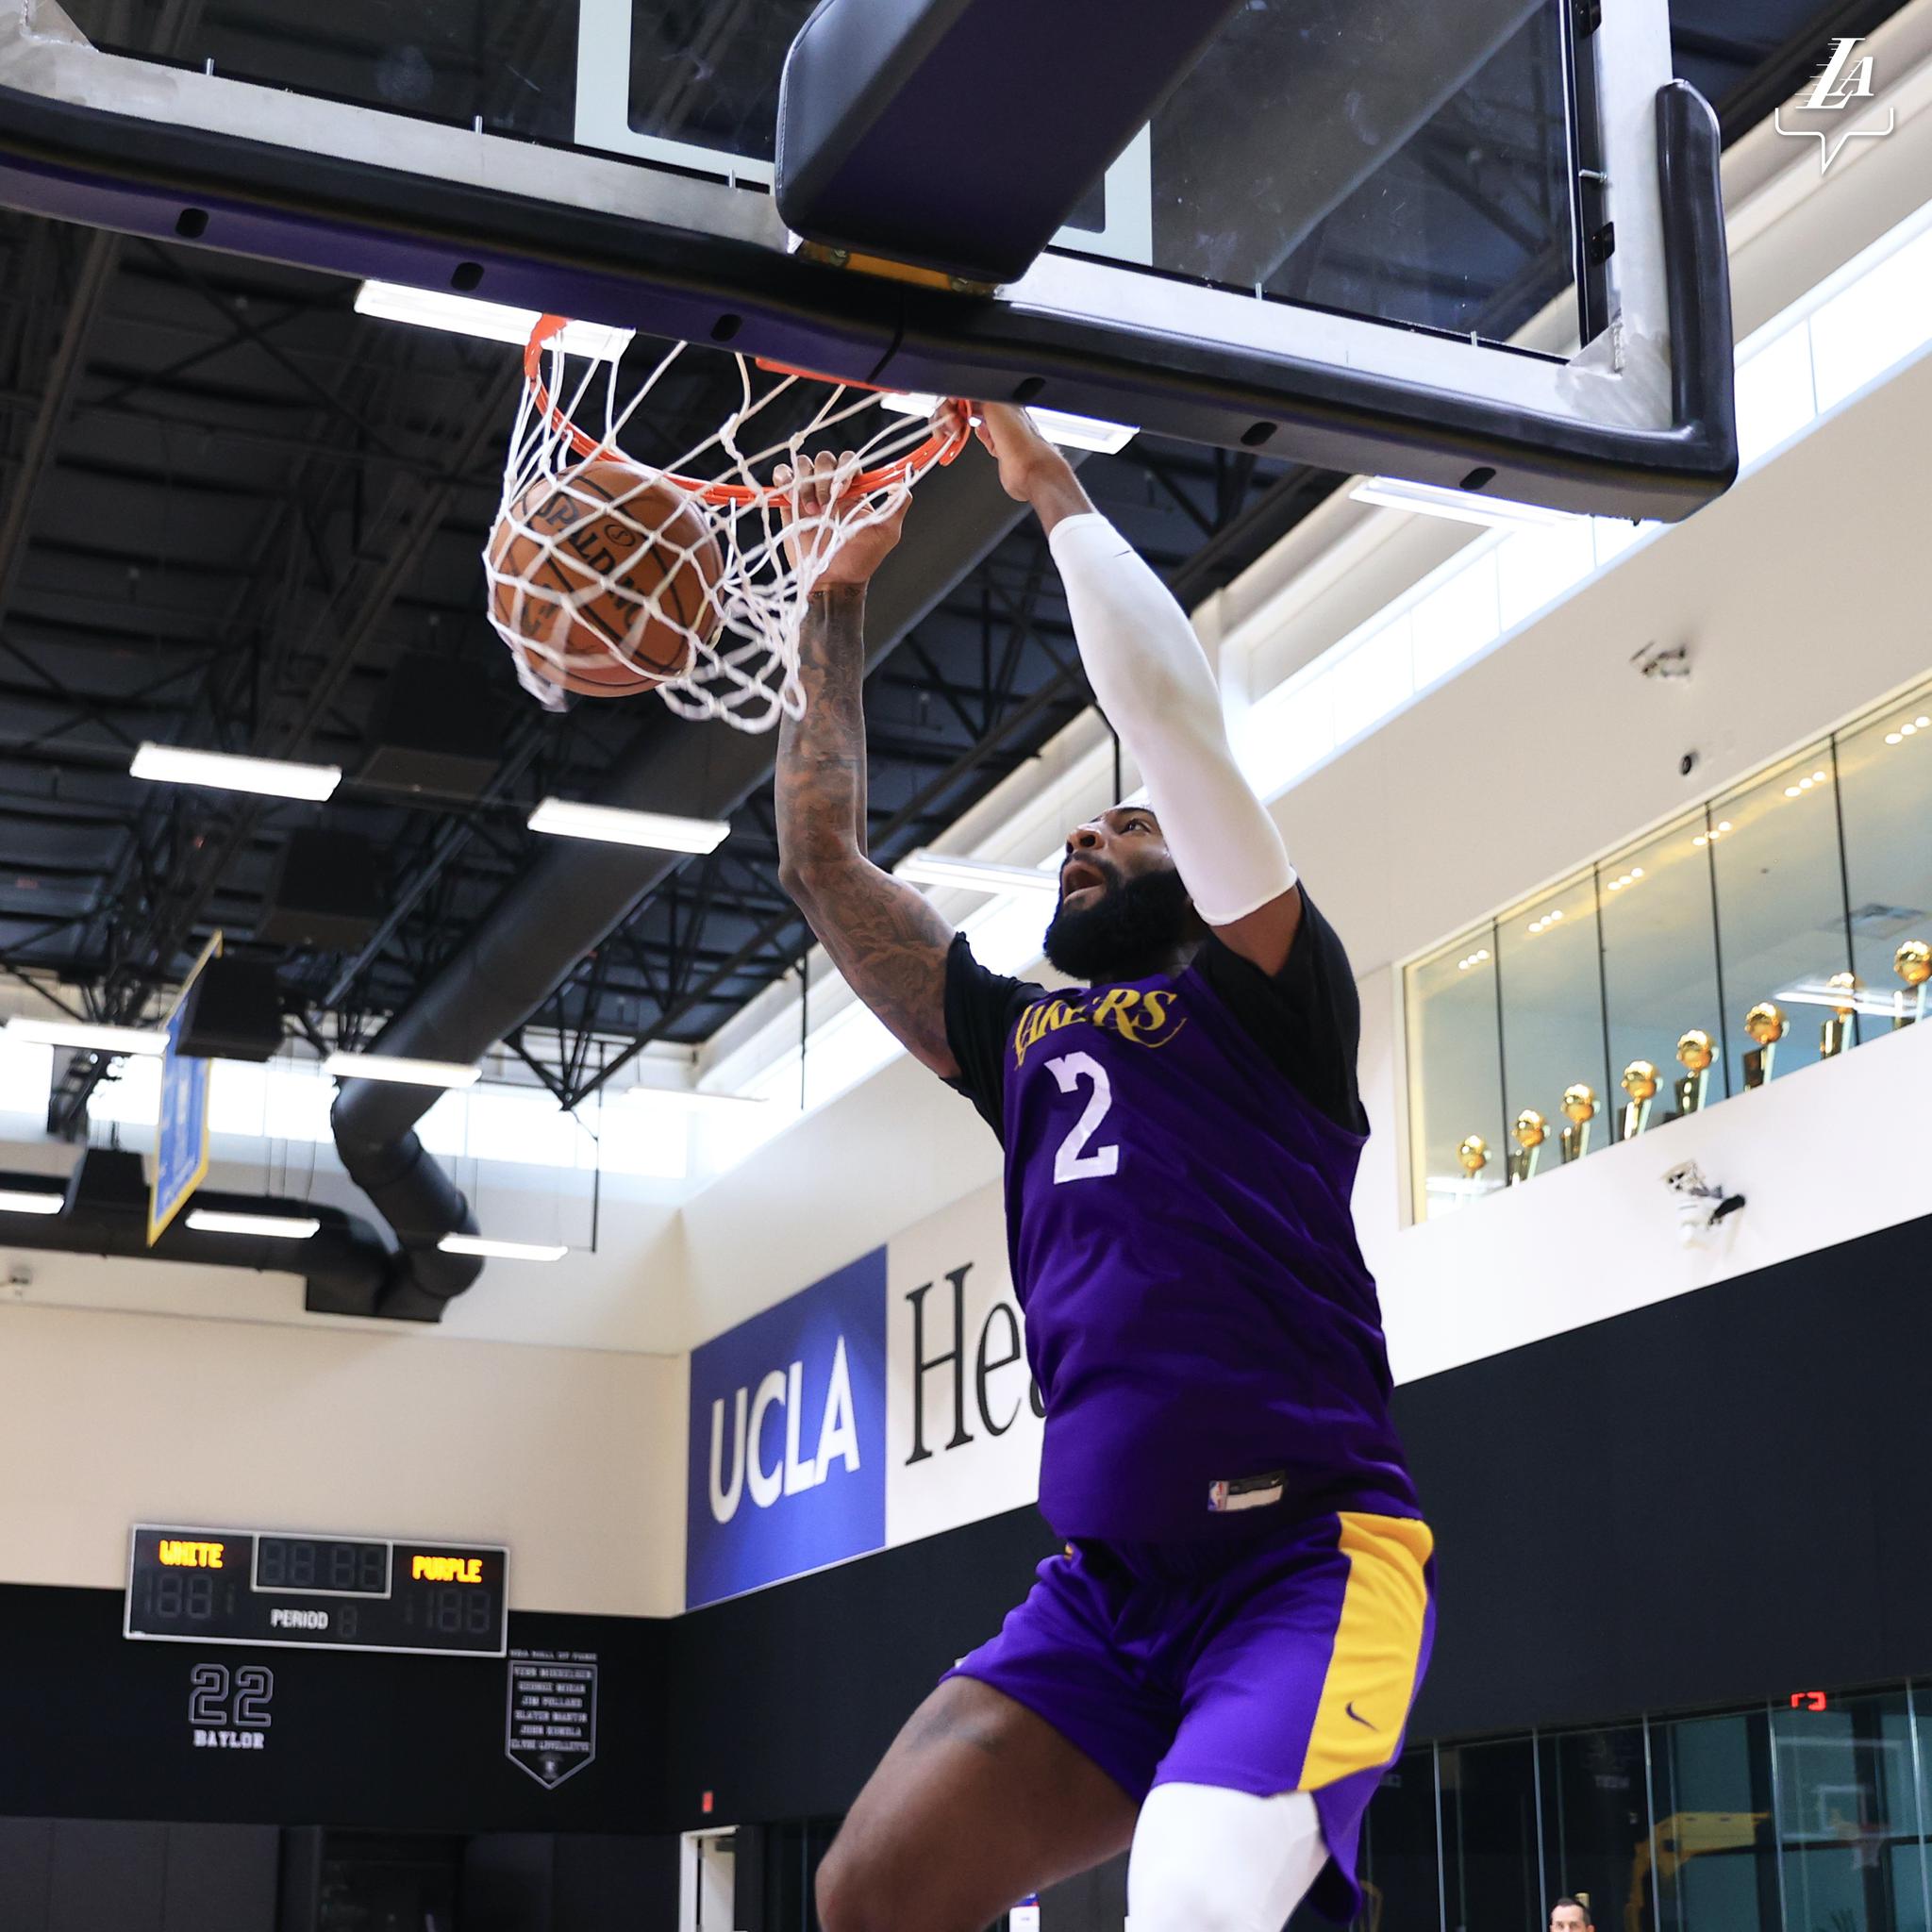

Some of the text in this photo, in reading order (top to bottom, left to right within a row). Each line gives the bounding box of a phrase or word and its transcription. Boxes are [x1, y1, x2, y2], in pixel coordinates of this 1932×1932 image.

[1042, 1050, 1120, 1186] 2
[708, 1334, 860, 1524] UCLA
[158, 1539, 225, 1569] WHITE
[411, 1556, 483, 1584] PURPLE
[271, 1608, 329, 1630] PERIOD
[189, 1663, 274, 1727] 22
[193, 1729, 265, 1749] BAYLOR
